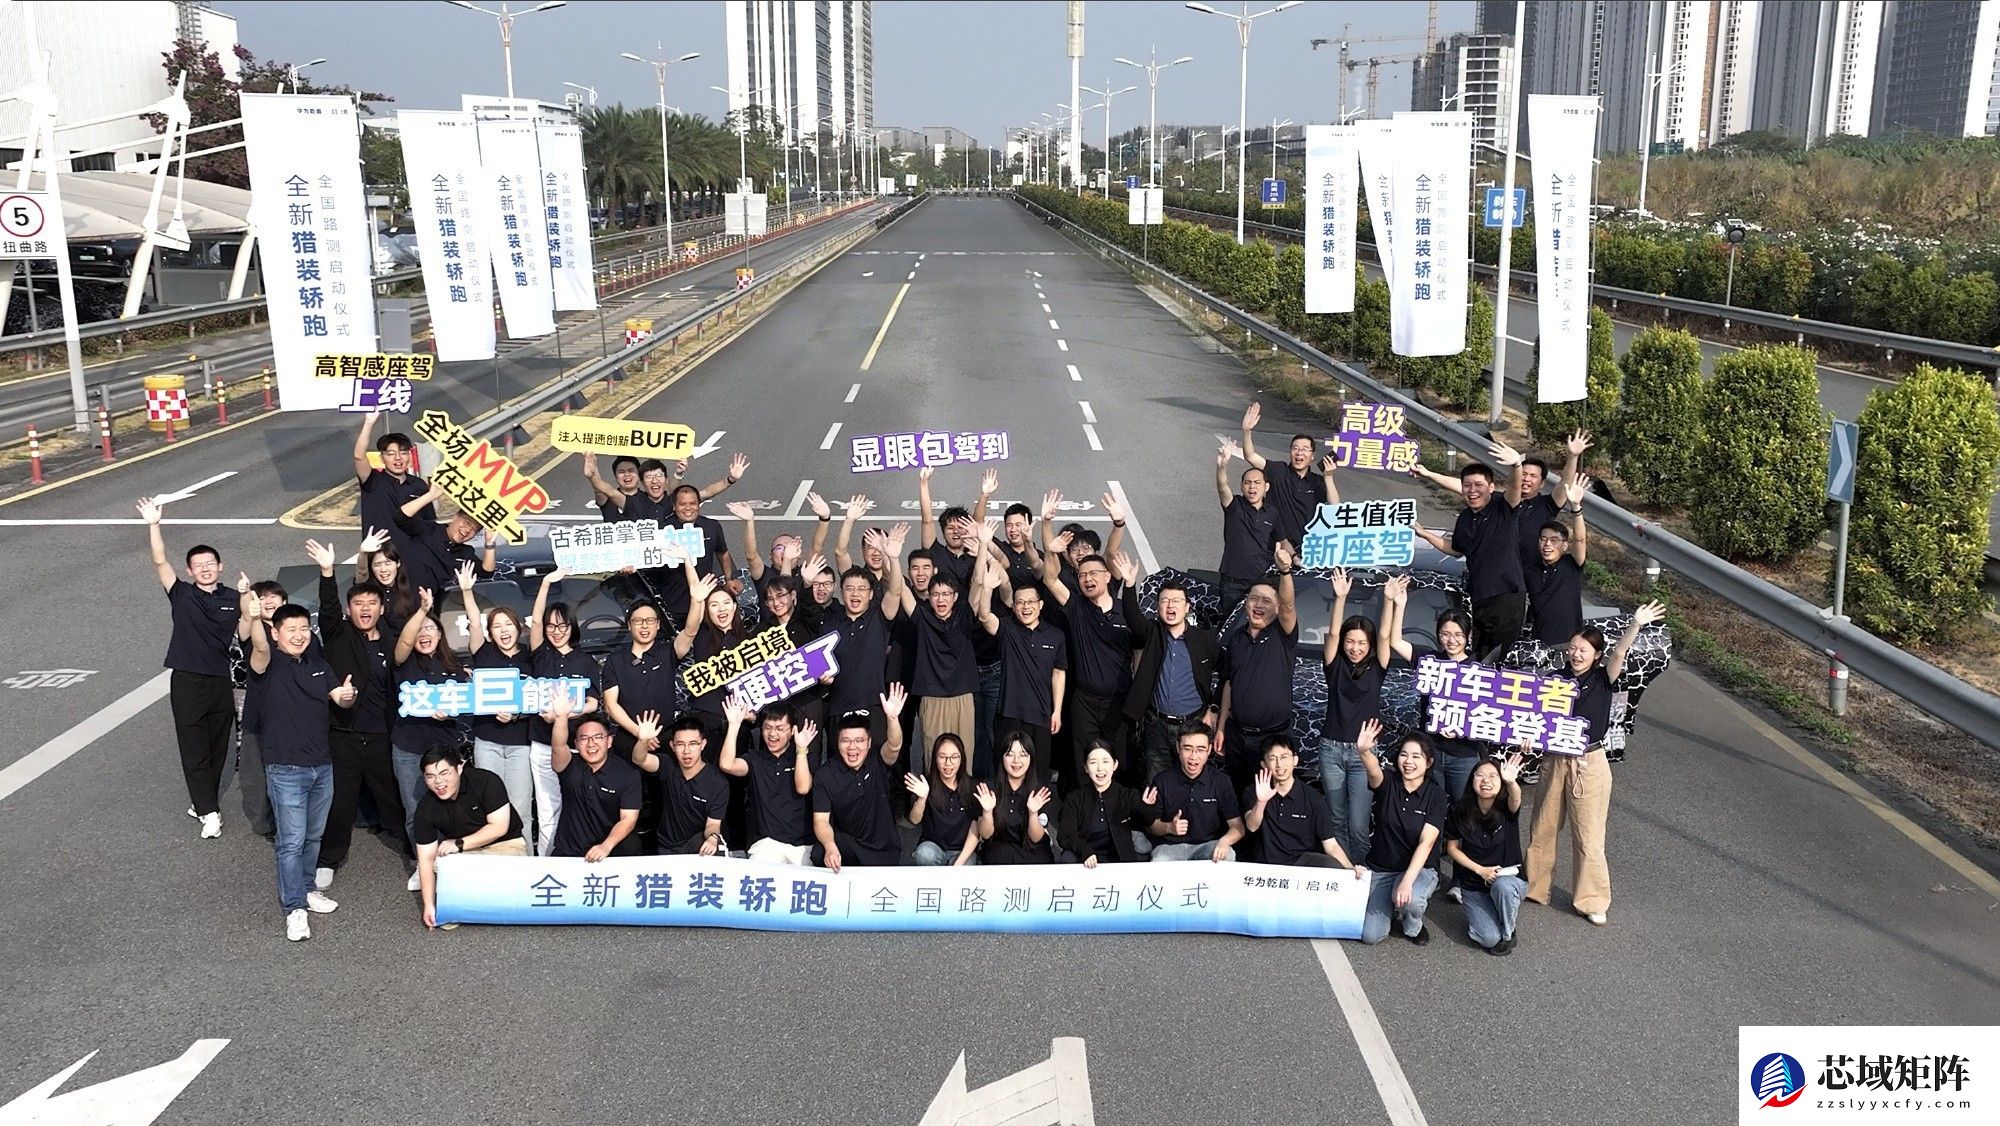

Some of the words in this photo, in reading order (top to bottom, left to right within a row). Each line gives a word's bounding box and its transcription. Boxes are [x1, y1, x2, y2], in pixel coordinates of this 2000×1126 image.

[14, 207, 29, 226] 5
[431, 174, 467, 303] 全新猎装轿跑
[498, 175, 528, 287] 全新猎装轿跑
[546, 172, 562, 269] 全新猎装轿跑
[1322, 172, 1335, 270] 全新猎装轿跑
[1414, 173, 1431, 301] 全新猎装轿跑
[3, 241, 47, 253] 扭曲路
[285, 174, 328, 337] 全新猎装轿跑
[318, 174, 350, 337] 全国路测启动仪式
[315, 355, 433, 378] 高智感座驾
[339, 380, 412, 413] 上线
[558, 430, 688, 449] 注入提速创新BUFF
[1342, 404, 1406, 437] 高级
[417, 413, 548, 512] 全场MVP
[851, 432, 1009, 473] 显眼包驾到
[1325, 437, 1419, 473] 力量感
[433, 461, 509, 532] 在这里
[1307, 501, 1415, 530] 人生值得
[552, 522, 655, 549] 古希腊掌管
[1302, 530, 1414, 567] 新座驾
[686, 629, 791, 694] 我被启境
[728, 632, 840, 712] 硬控了
[400, 669, 589, 716] 这车巨能打
[1416, 657, 1579, 716] 新车王者
[1427, 697, 1590, 755] 预备登基
[530, 872, 828, 916] 全新猎装轿跑
[870, 883, 1210, 914] 全国路测启动仪式
[1243, 875, 1289, 890] 华为乾崑
